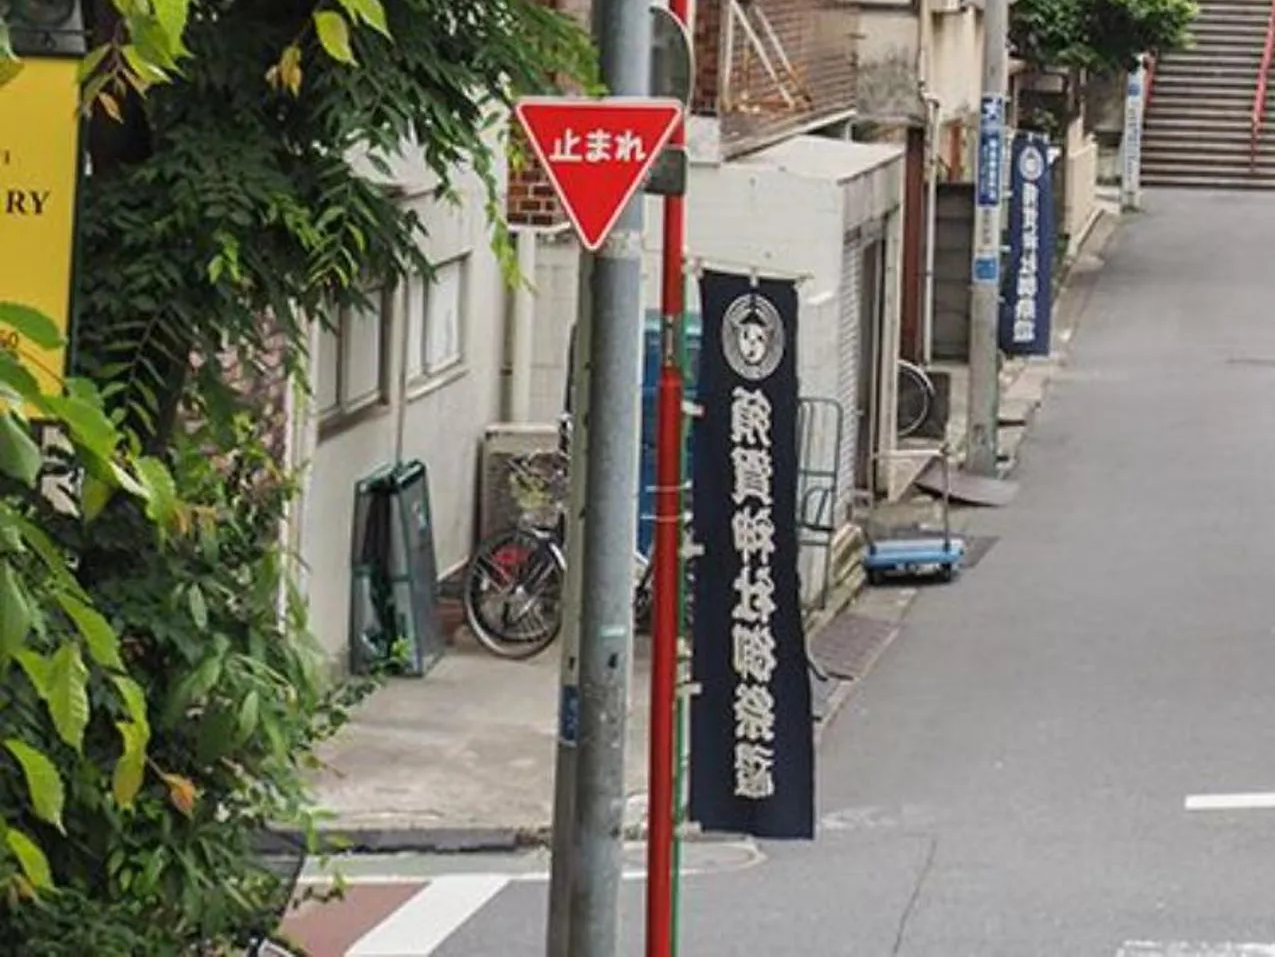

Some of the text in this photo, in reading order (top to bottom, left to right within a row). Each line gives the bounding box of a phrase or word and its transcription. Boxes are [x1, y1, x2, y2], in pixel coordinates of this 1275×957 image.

[549, 127, 647, 163] 止まれ
[6, 189, 51, 216] RY
